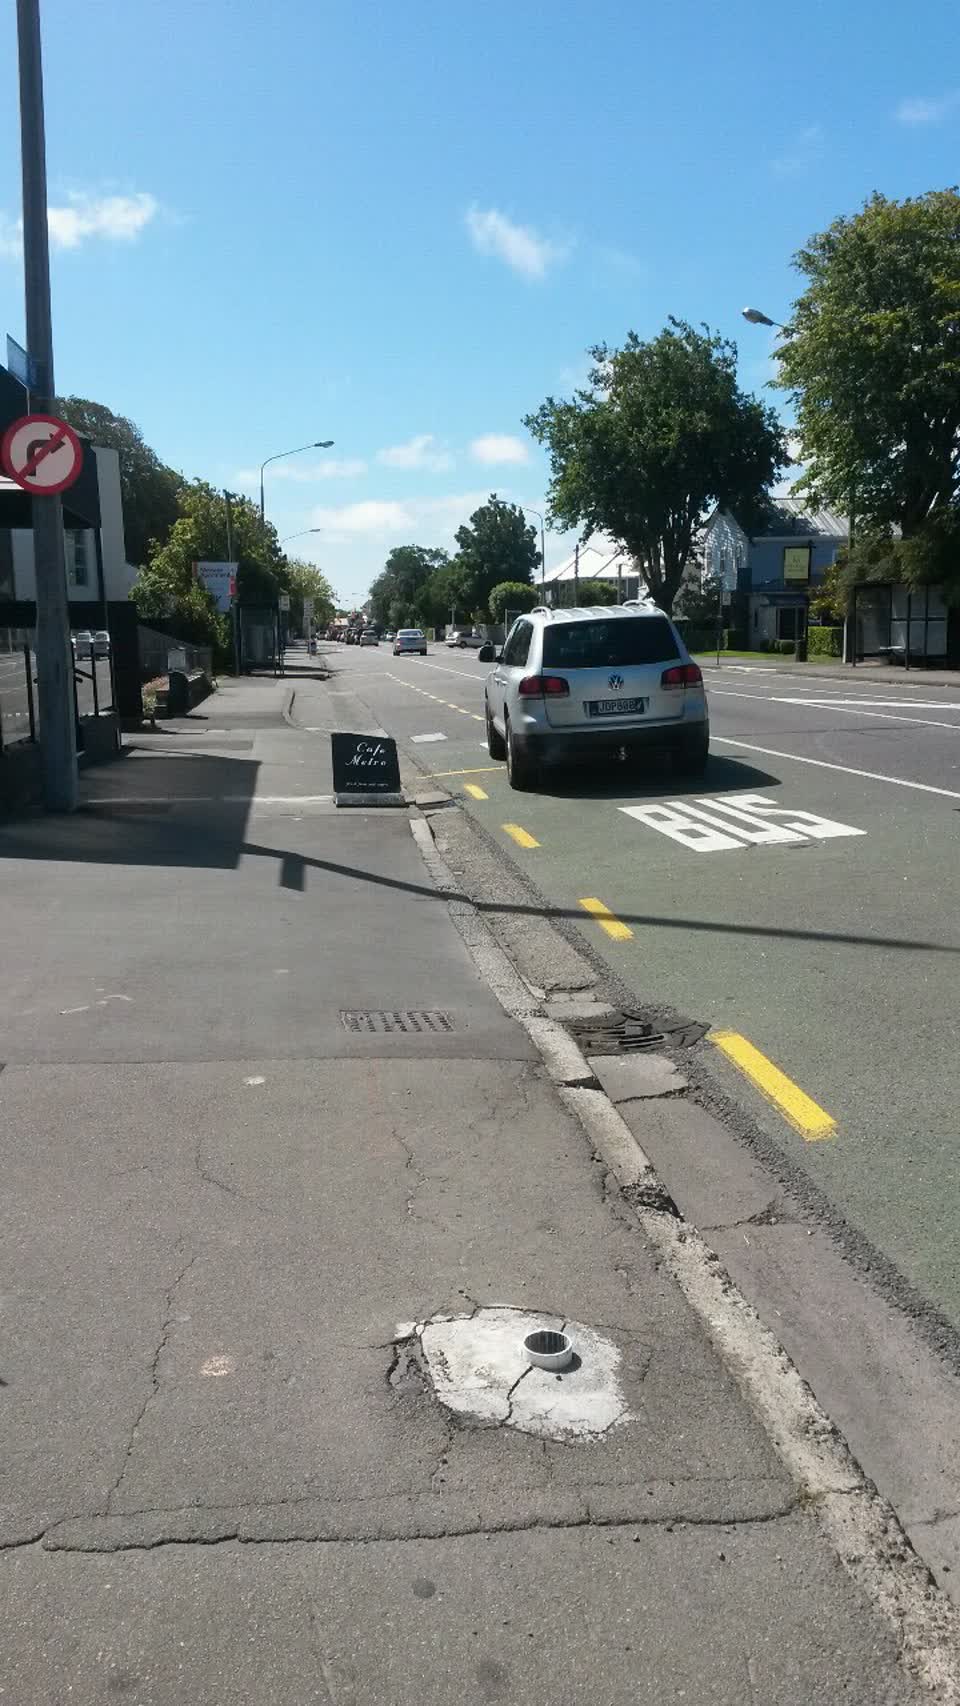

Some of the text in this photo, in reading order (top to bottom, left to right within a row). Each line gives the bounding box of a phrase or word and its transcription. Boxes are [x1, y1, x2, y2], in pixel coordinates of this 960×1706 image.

[356, 742, 386, 756] Cafe
[345, 754, 387, 766] Metro
[616, 793, 868, 852] BUS
